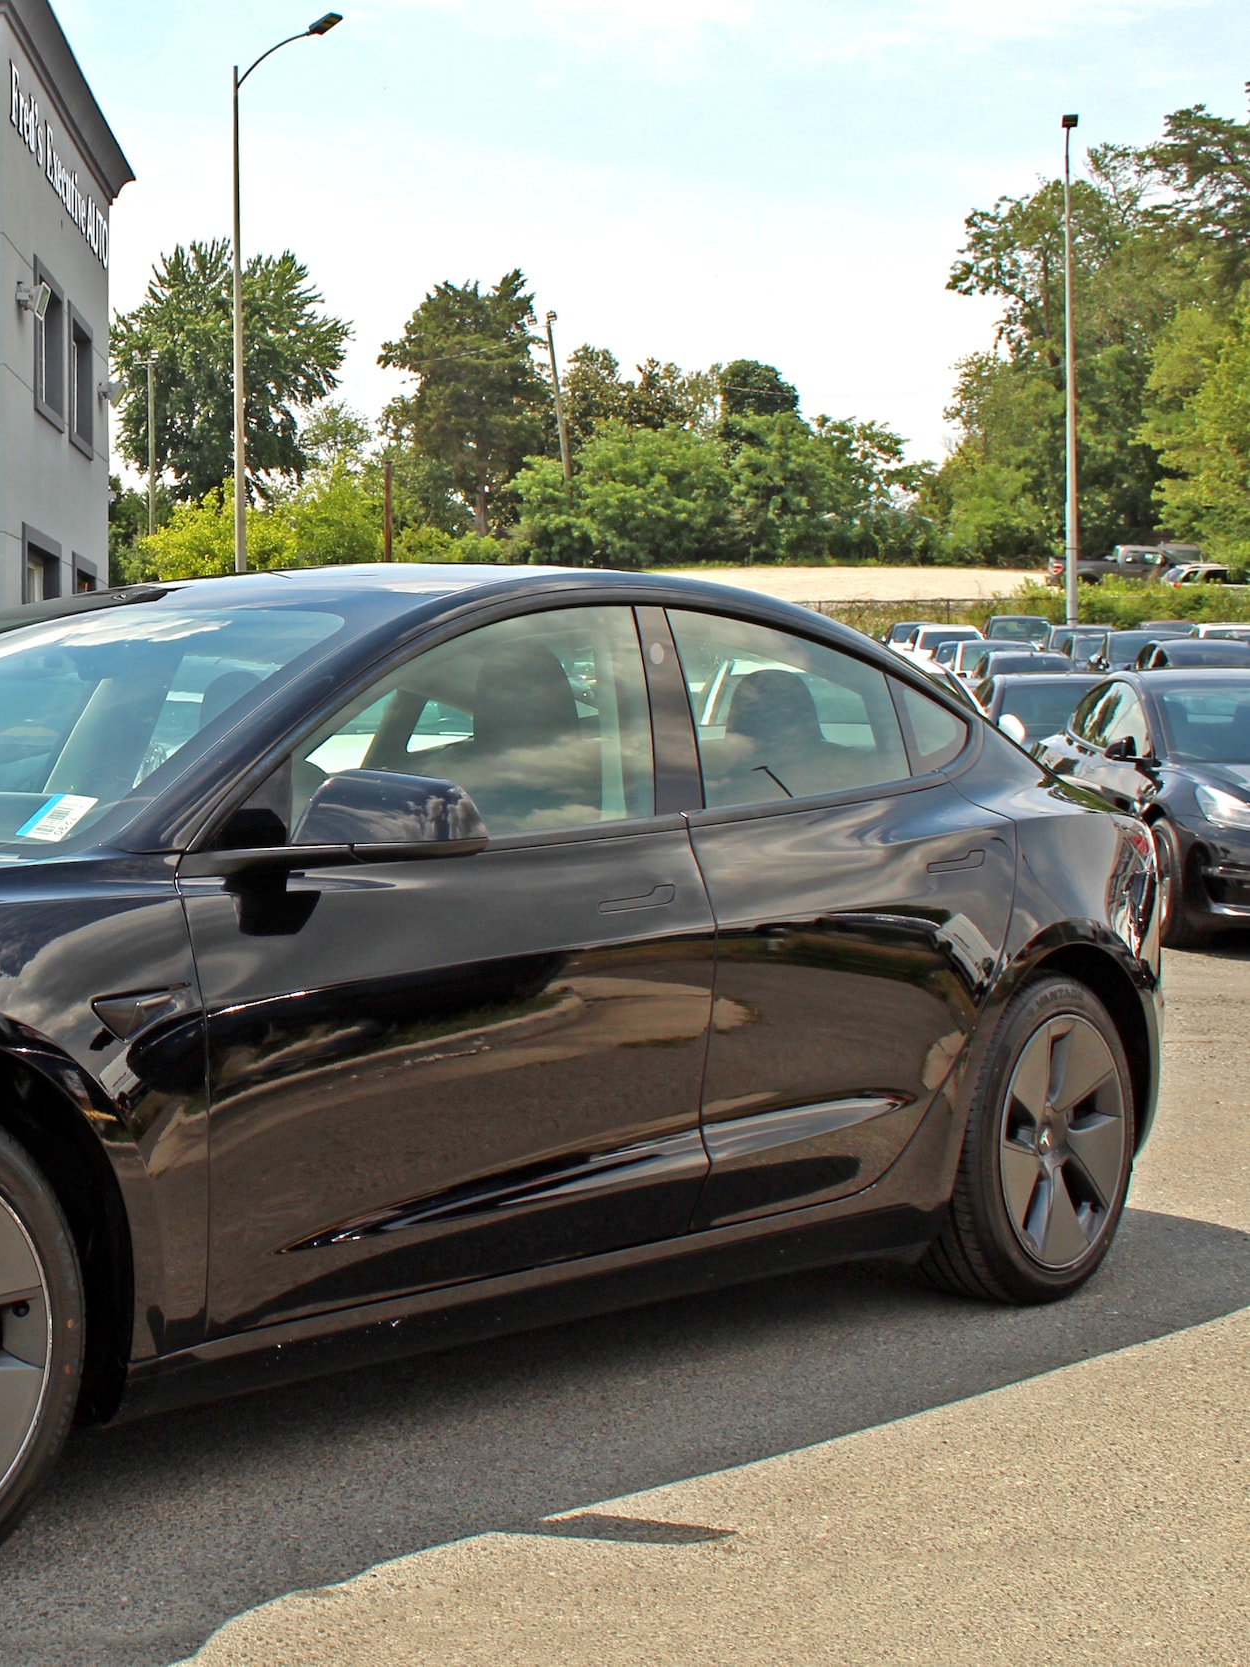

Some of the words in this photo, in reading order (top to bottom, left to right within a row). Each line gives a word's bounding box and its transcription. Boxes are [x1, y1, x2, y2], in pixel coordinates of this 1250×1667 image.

[9, 59, 43, 168] Fred's
[44, 119, 87, 234] Executive
[86, 195, 110, 269] AUTO
